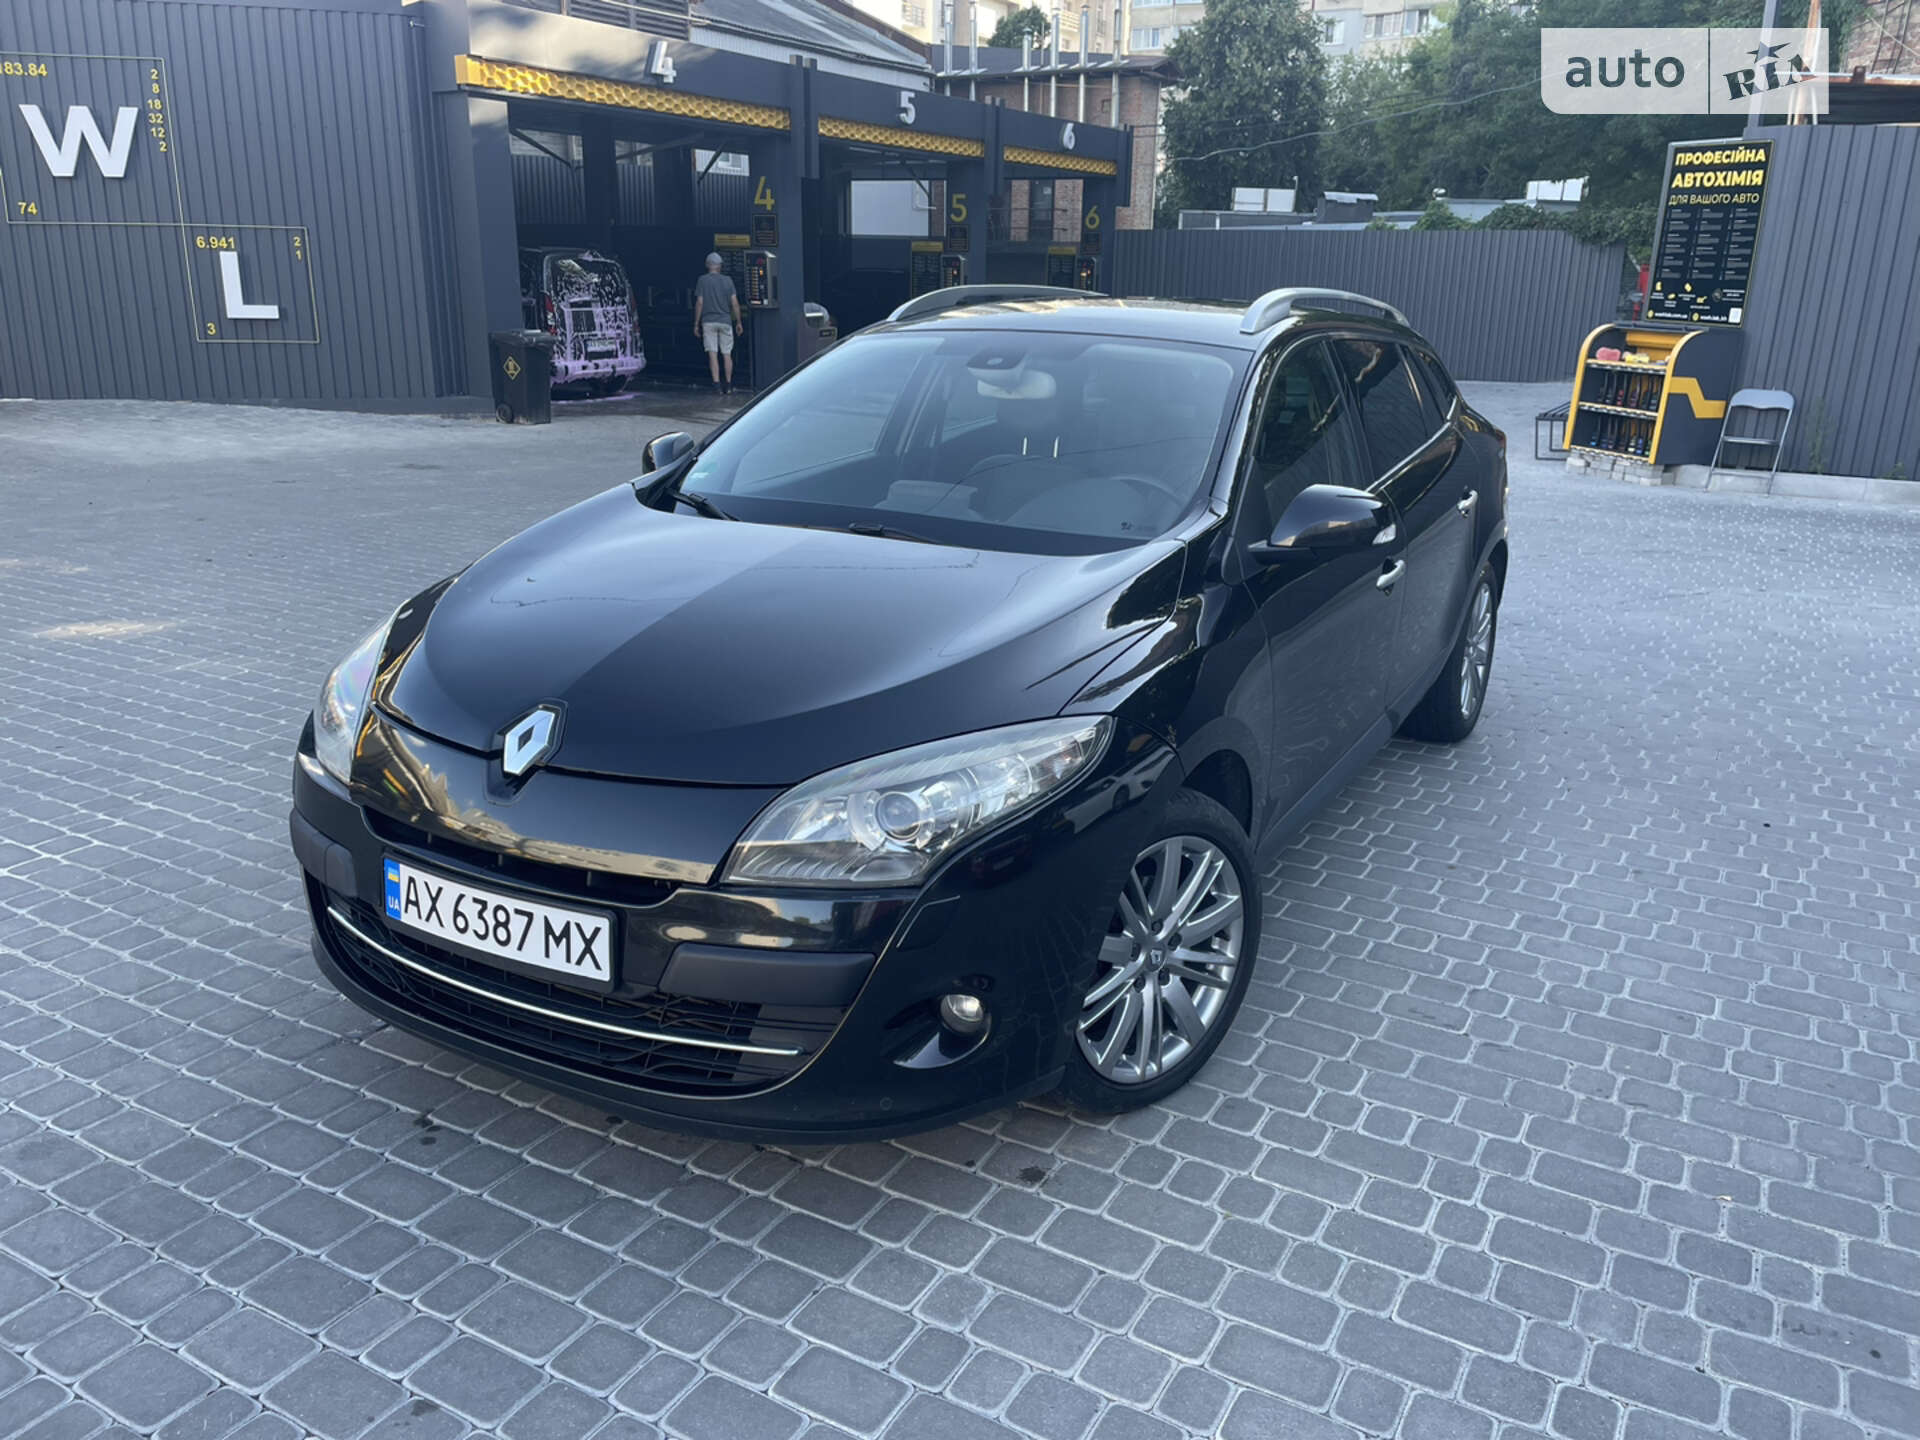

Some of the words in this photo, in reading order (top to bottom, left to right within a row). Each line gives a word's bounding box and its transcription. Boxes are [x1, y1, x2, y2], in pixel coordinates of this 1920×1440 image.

[650, 41, 677, 84] 4
[151, 68, 159, 80] 2
[152, 83, 160, 94] 8
[147, 99, 162, 110] 18
[898, 91, 916, 125] 5
[148, 113, 163, 124] 32
[150, 127, 165, 138] 12
[1062, 122, 1076, 151] 6
[18, 104, 139, 178] W
[159, 141, 167, 152] 2
[1675, 146, 1766, 166] ПРОФЕСІЙНА
[1671, 169, 1764, 188] АВТОХІМІЯ
[754, 177, 774, 212] 4
[1668, 195, 1688, 206] ДЛЯ
[1689, 194, 1731, 205] ВАШОГО
[1732, 192, 1760, 203] АВТО
[18, 201, 38, 215] 74
[951, 193, 967, 222] 5
[1084, 205, 1100, 230] 6
[196, 235, 236, 249] 6.941
[293, 236, 302, 247] 2
[296, 250, 303, 260] 1
[219, 251, 280, 319] L
[207, 322, 216, 335] 3
[388, 895, 400, 911] UA
[404, 876, 444, 928] AX
[453, 893, 534, 951] 6387
[544, 915, 602, 971] MX
